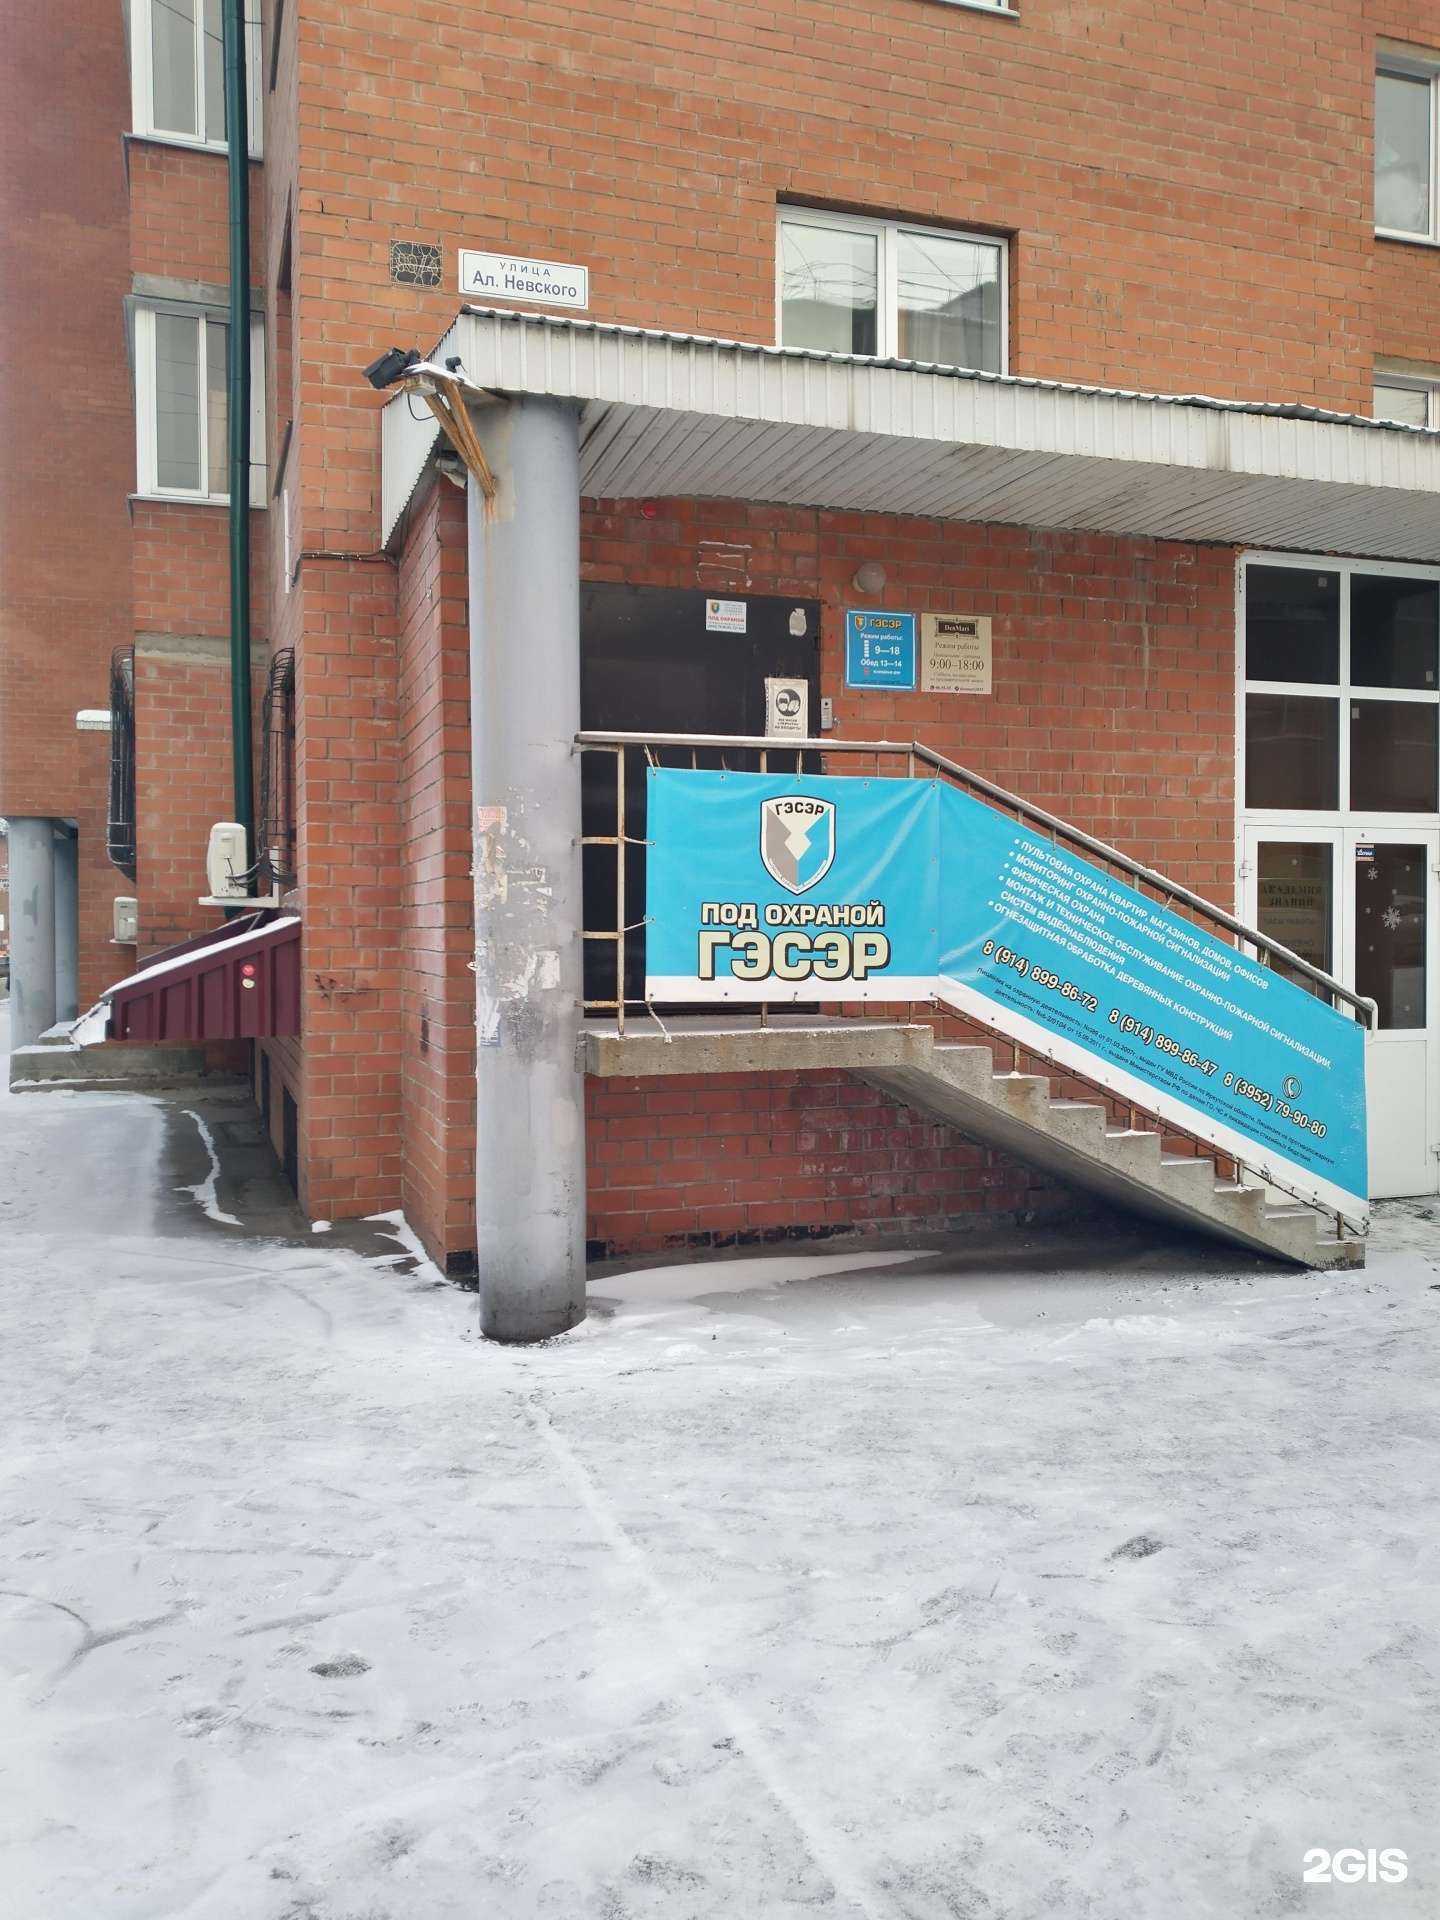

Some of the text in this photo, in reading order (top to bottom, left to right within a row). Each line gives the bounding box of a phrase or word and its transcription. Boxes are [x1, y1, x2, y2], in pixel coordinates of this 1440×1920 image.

[472, 270, 577, 298] Ал. Невского
[499, 261, 551, 277] УЛИЦА
[869, 618, 902, 628] ГЭСЭР
[774, 802, 825, 815] ГЭСЭР
[701, 900, 886, 929] ПОД ОХРАНОЙ
[1011, 865, 1105, 923] ФИЗИЧЕСКАЯ ОХРАНА
[1016, 854, 1230, 981] МОНИТОРИНГ ОХРАННО-ПОЖАРНОЙ СИГНАЛИЗАЦИИ
[1022, 841, 1268, 989] ПУЛЬТОВАЯ ОХРАНА КВАРТИР, МАГАЗИНОВ, ДОМОВ, ОФИСОВ
[697, 930, 891, 982] ГЭСЭР
[1001, 890, 1124, 965] СИСТЕМ ВИДЕОНАБЛЮДЕНИЯ
[1006, 877, 1044, 904] МОНТАЖ
[1047, 900, 1053, 908] И
[1055, 905, 1114, 943] ТЕХНИЧЕСКОЕ
[1115, 939, 1183, 982] ОБСЛУЖИВАНИЕ
[1184, 978, 1269, 1031] ОХРАННО-ПОЖАРНОЙ
[984, 940, 1098, 1011] 8 (914) 899-86-72
[994, 902, 1232, 1040] ОГНЕЗАЩИТНАЯ ОБРАБОТКА ДЕРЕВЯННЫХ КОНСТРУКЦИЙ
[1109, 1008, 1216, 1076] 8 (914) 899-86-47
[1223, 1072, 1326, 1137] 8 (3952) 79-90-80
